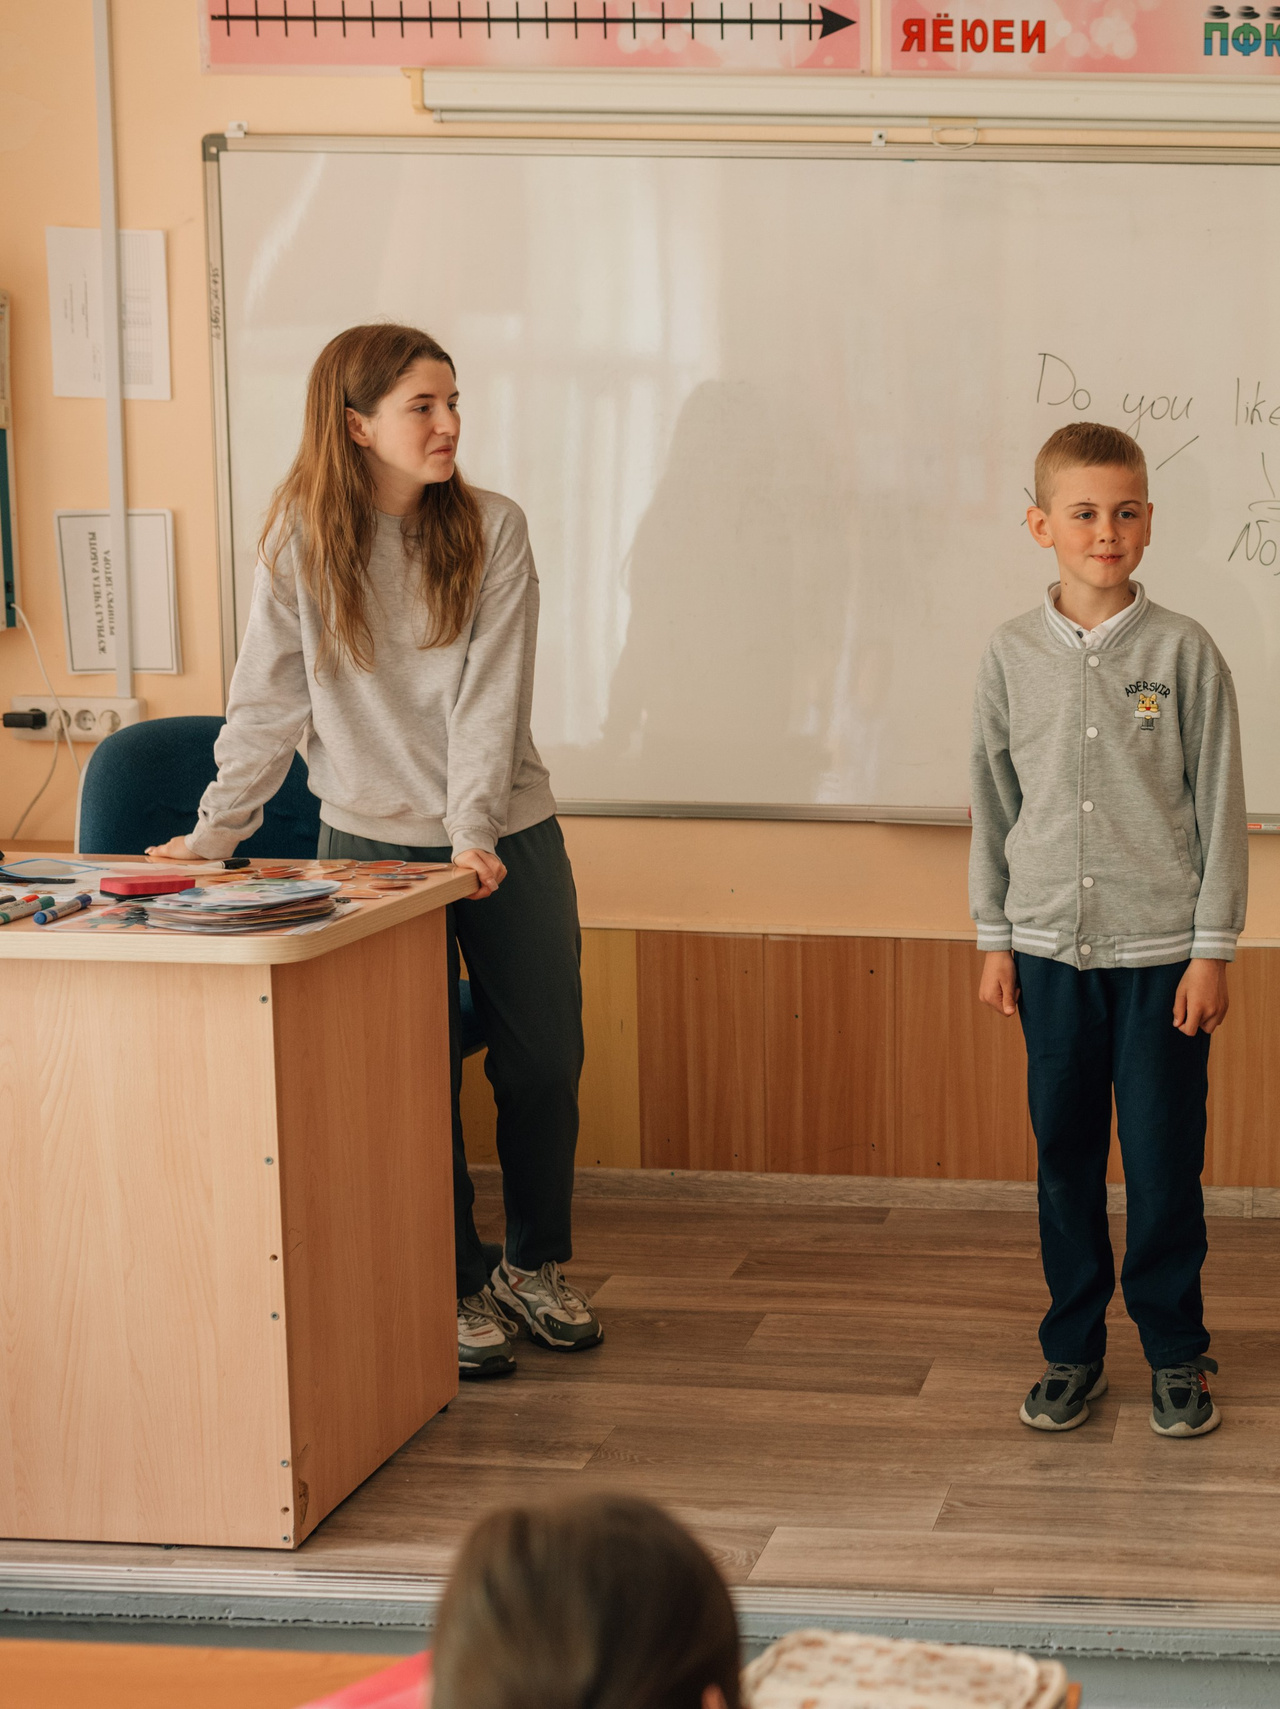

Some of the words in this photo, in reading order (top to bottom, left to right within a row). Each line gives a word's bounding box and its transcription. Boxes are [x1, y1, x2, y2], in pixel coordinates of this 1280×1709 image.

[901, 13, 1046, 54] ЯЁЮЕИ
[1036, 353, 1092, 411] Do
[1122, 393, 1194, 440] you
